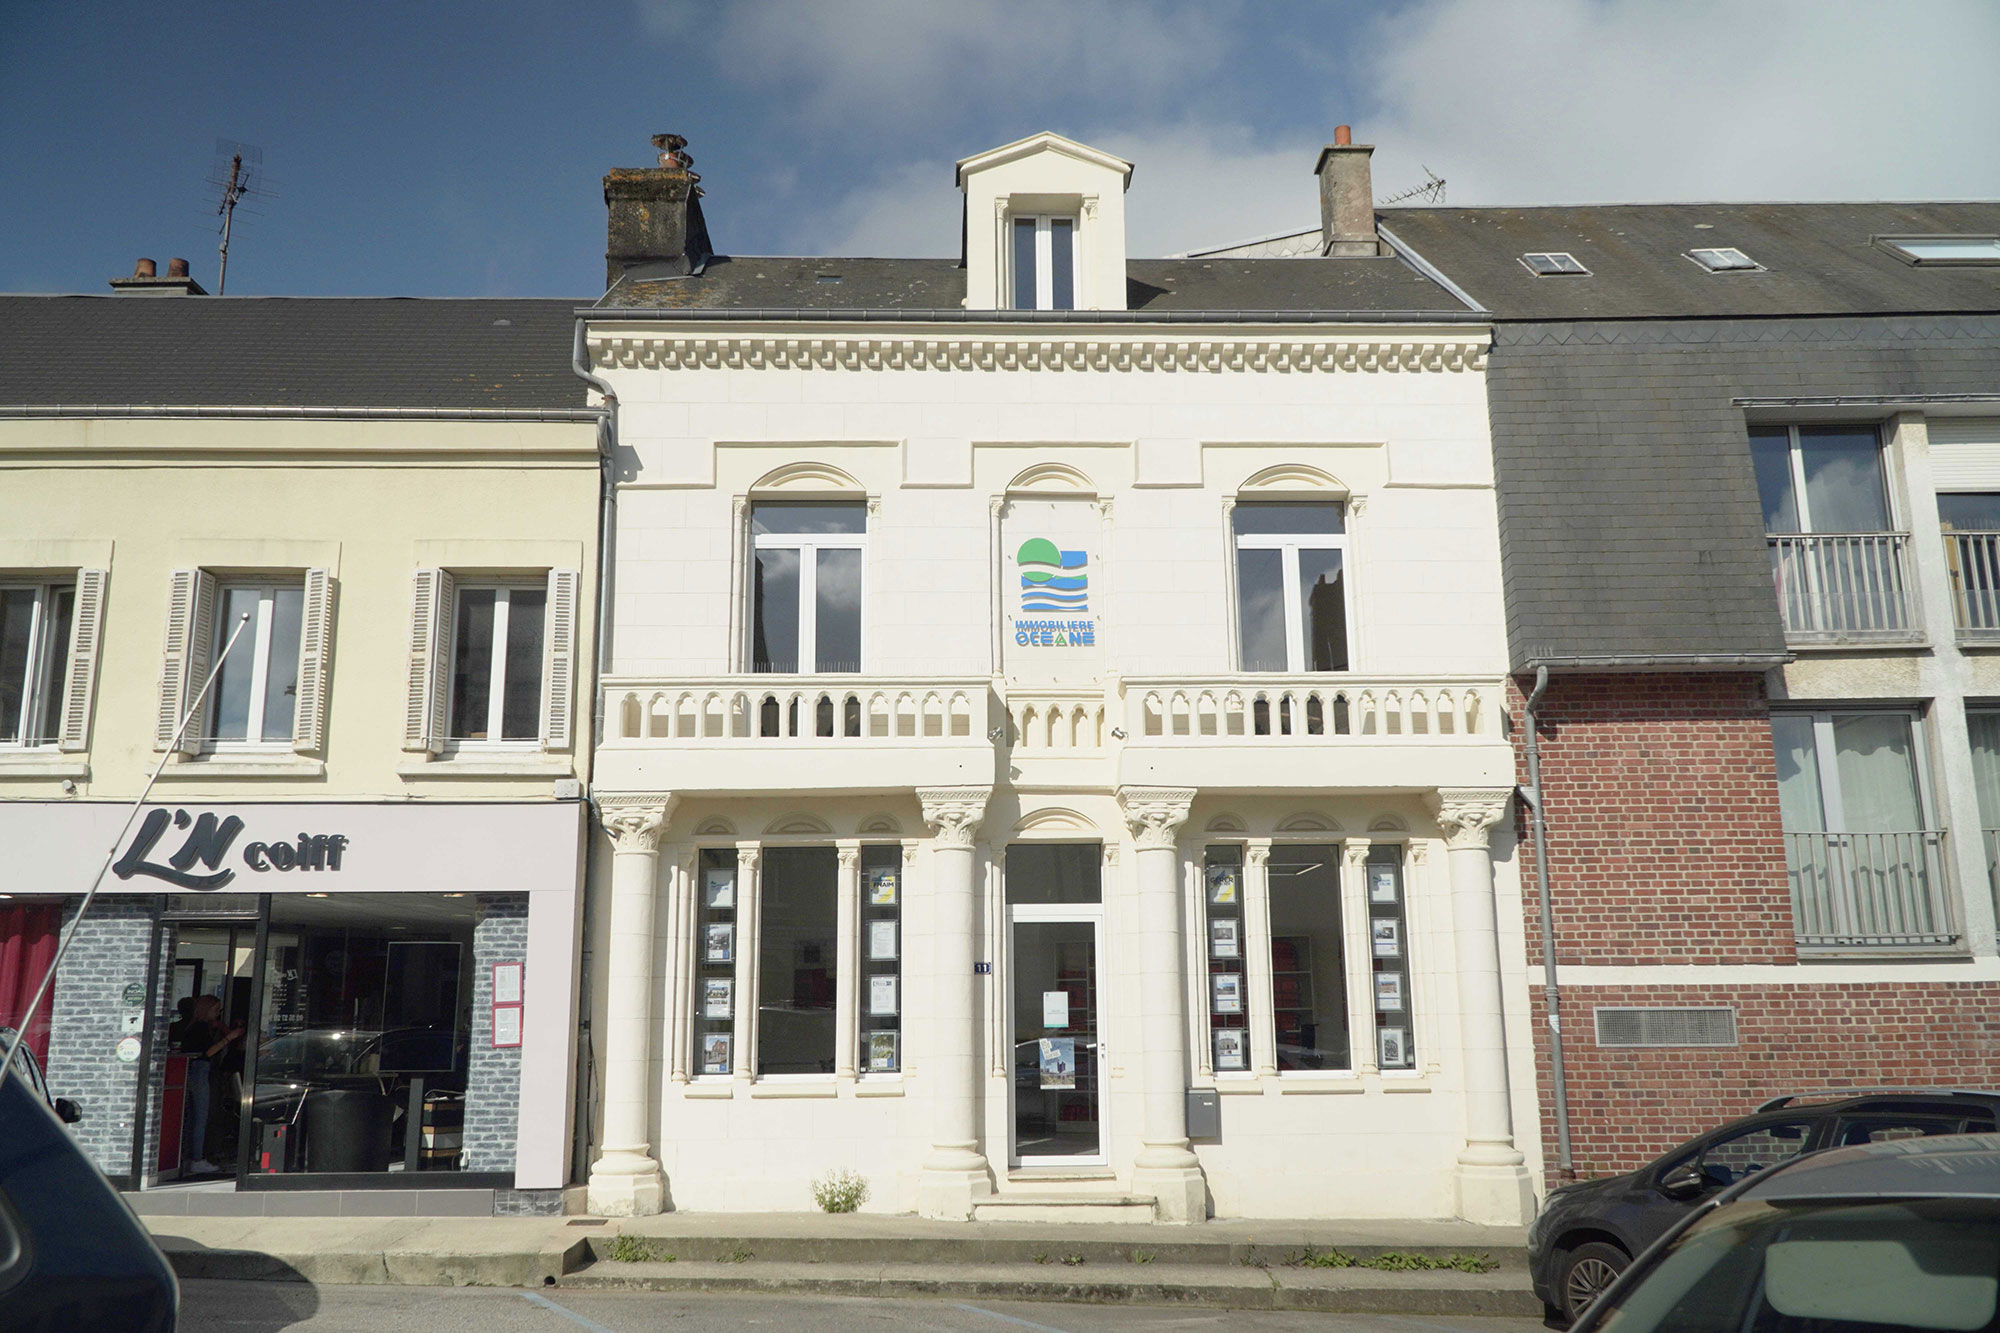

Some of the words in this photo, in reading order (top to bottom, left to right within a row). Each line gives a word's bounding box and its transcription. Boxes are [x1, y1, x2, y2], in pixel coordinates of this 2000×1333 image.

[1015, 620, 1094, 631] IMMOBILIERE
[1015, 631, 1095, 646] OCEANE
[112, 808, 245, 891] L'N
[243, 832, 349, 872] coiff
